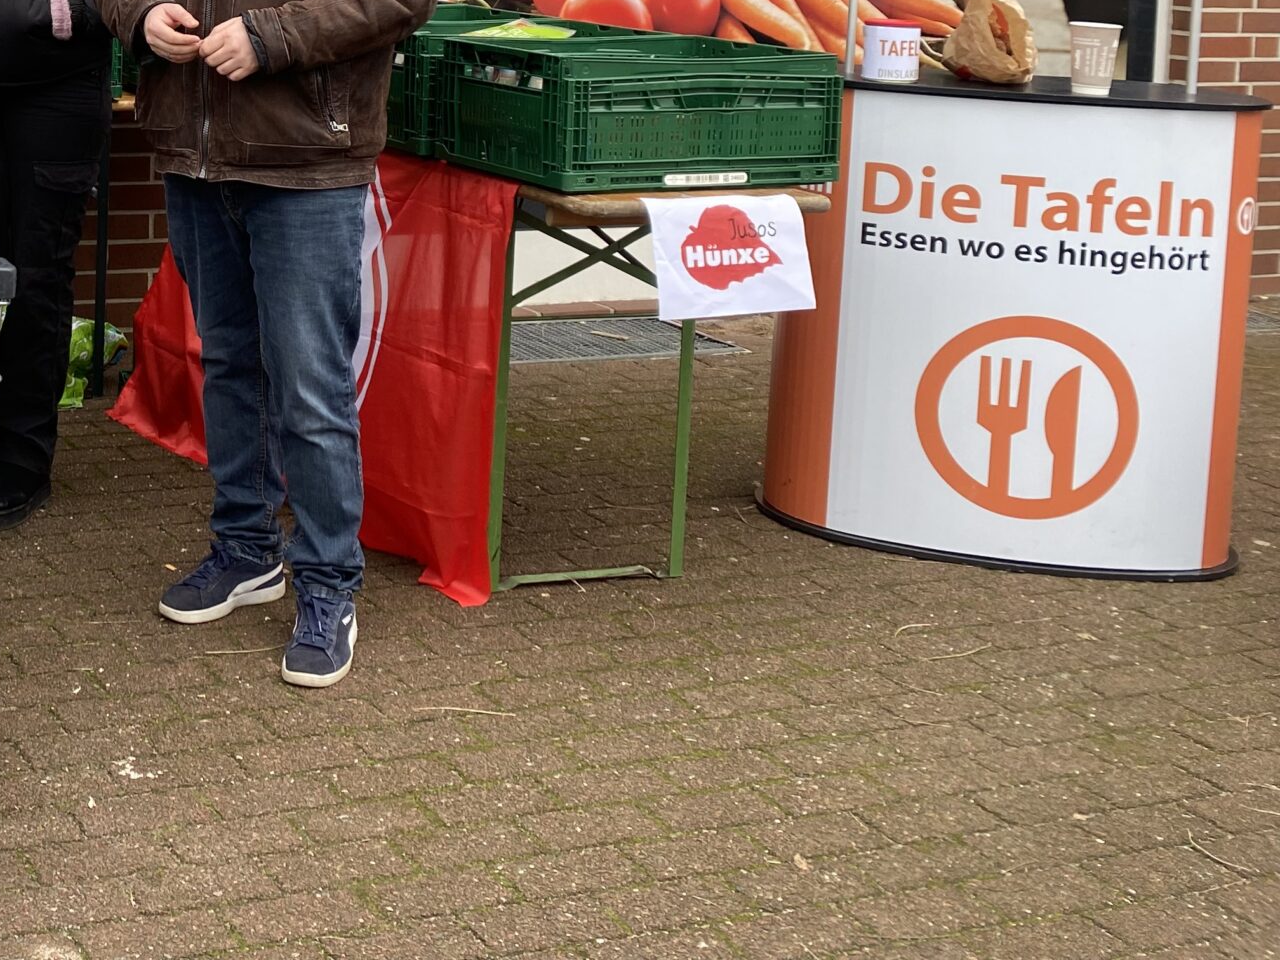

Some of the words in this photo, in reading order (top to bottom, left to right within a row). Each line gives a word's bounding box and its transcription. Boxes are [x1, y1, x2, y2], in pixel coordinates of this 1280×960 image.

[879, 39, 919, 57] TAFEL
[861, 161, 982, 224] Die
[1000, 173, 1216, 238] Tafeln
[685, 243, 770, 268] Hünxe
[860, 222, 948, 255] Essen
[958, 238, 1005, 259] wo
[1014, 243, 1049, 263] es
[1057, 240, 1211, 275] hingehört
